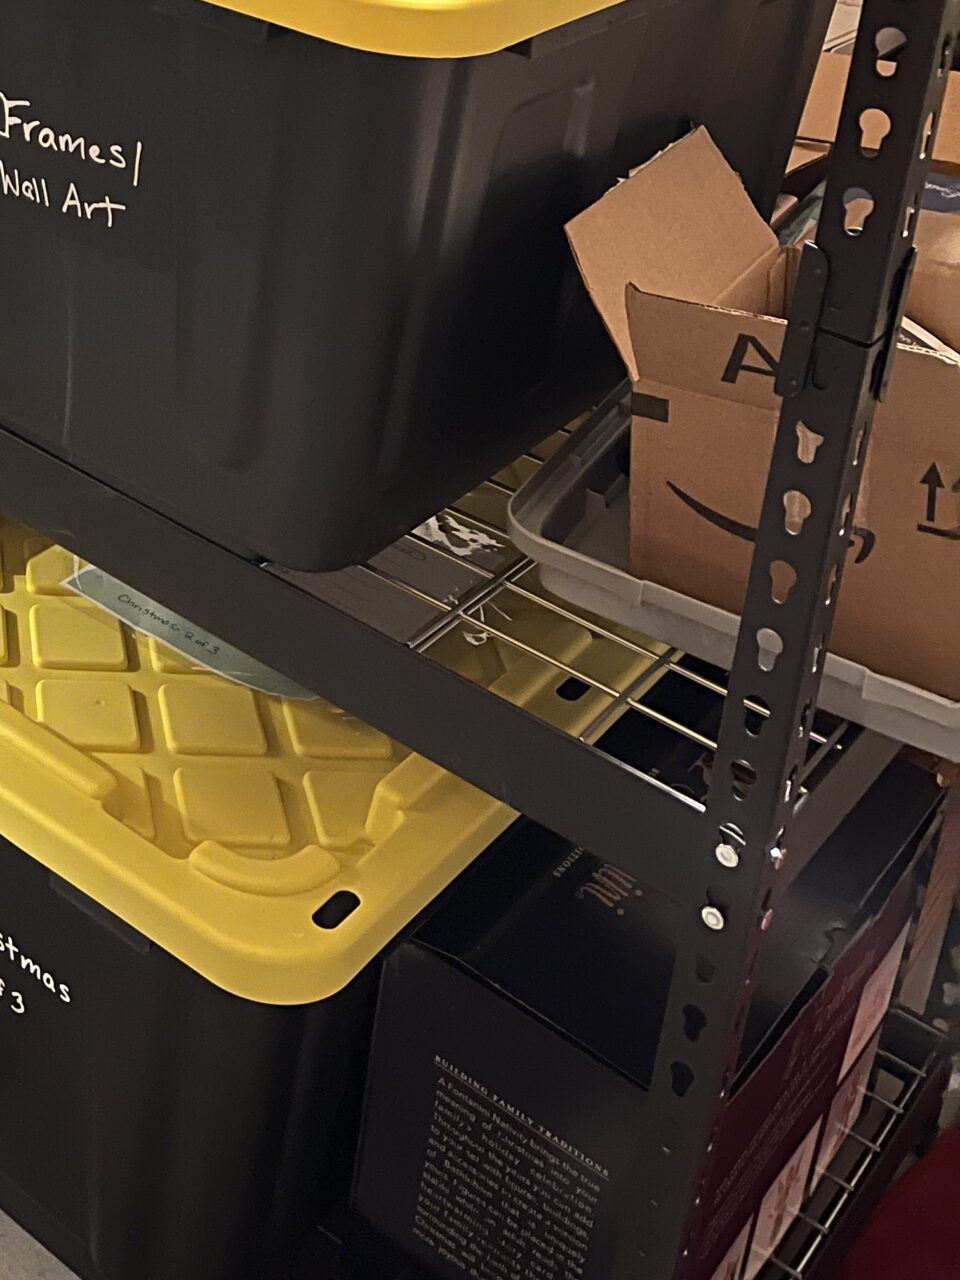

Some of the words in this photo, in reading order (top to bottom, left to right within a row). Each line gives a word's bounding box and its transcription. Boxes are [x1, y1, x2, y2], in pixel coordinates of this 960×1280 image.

[62, 182, 127, 228] Art
[194, 639, 209, 648] of
[207, 645, 221, 656] 3
[10, 991, 25, 1014] 3
[435, 1054, 487, 1095] BUILDING
[492, 1093, 532, 1126] FAMILY
[539, 1125, 608, 1177] TRADITIONS
